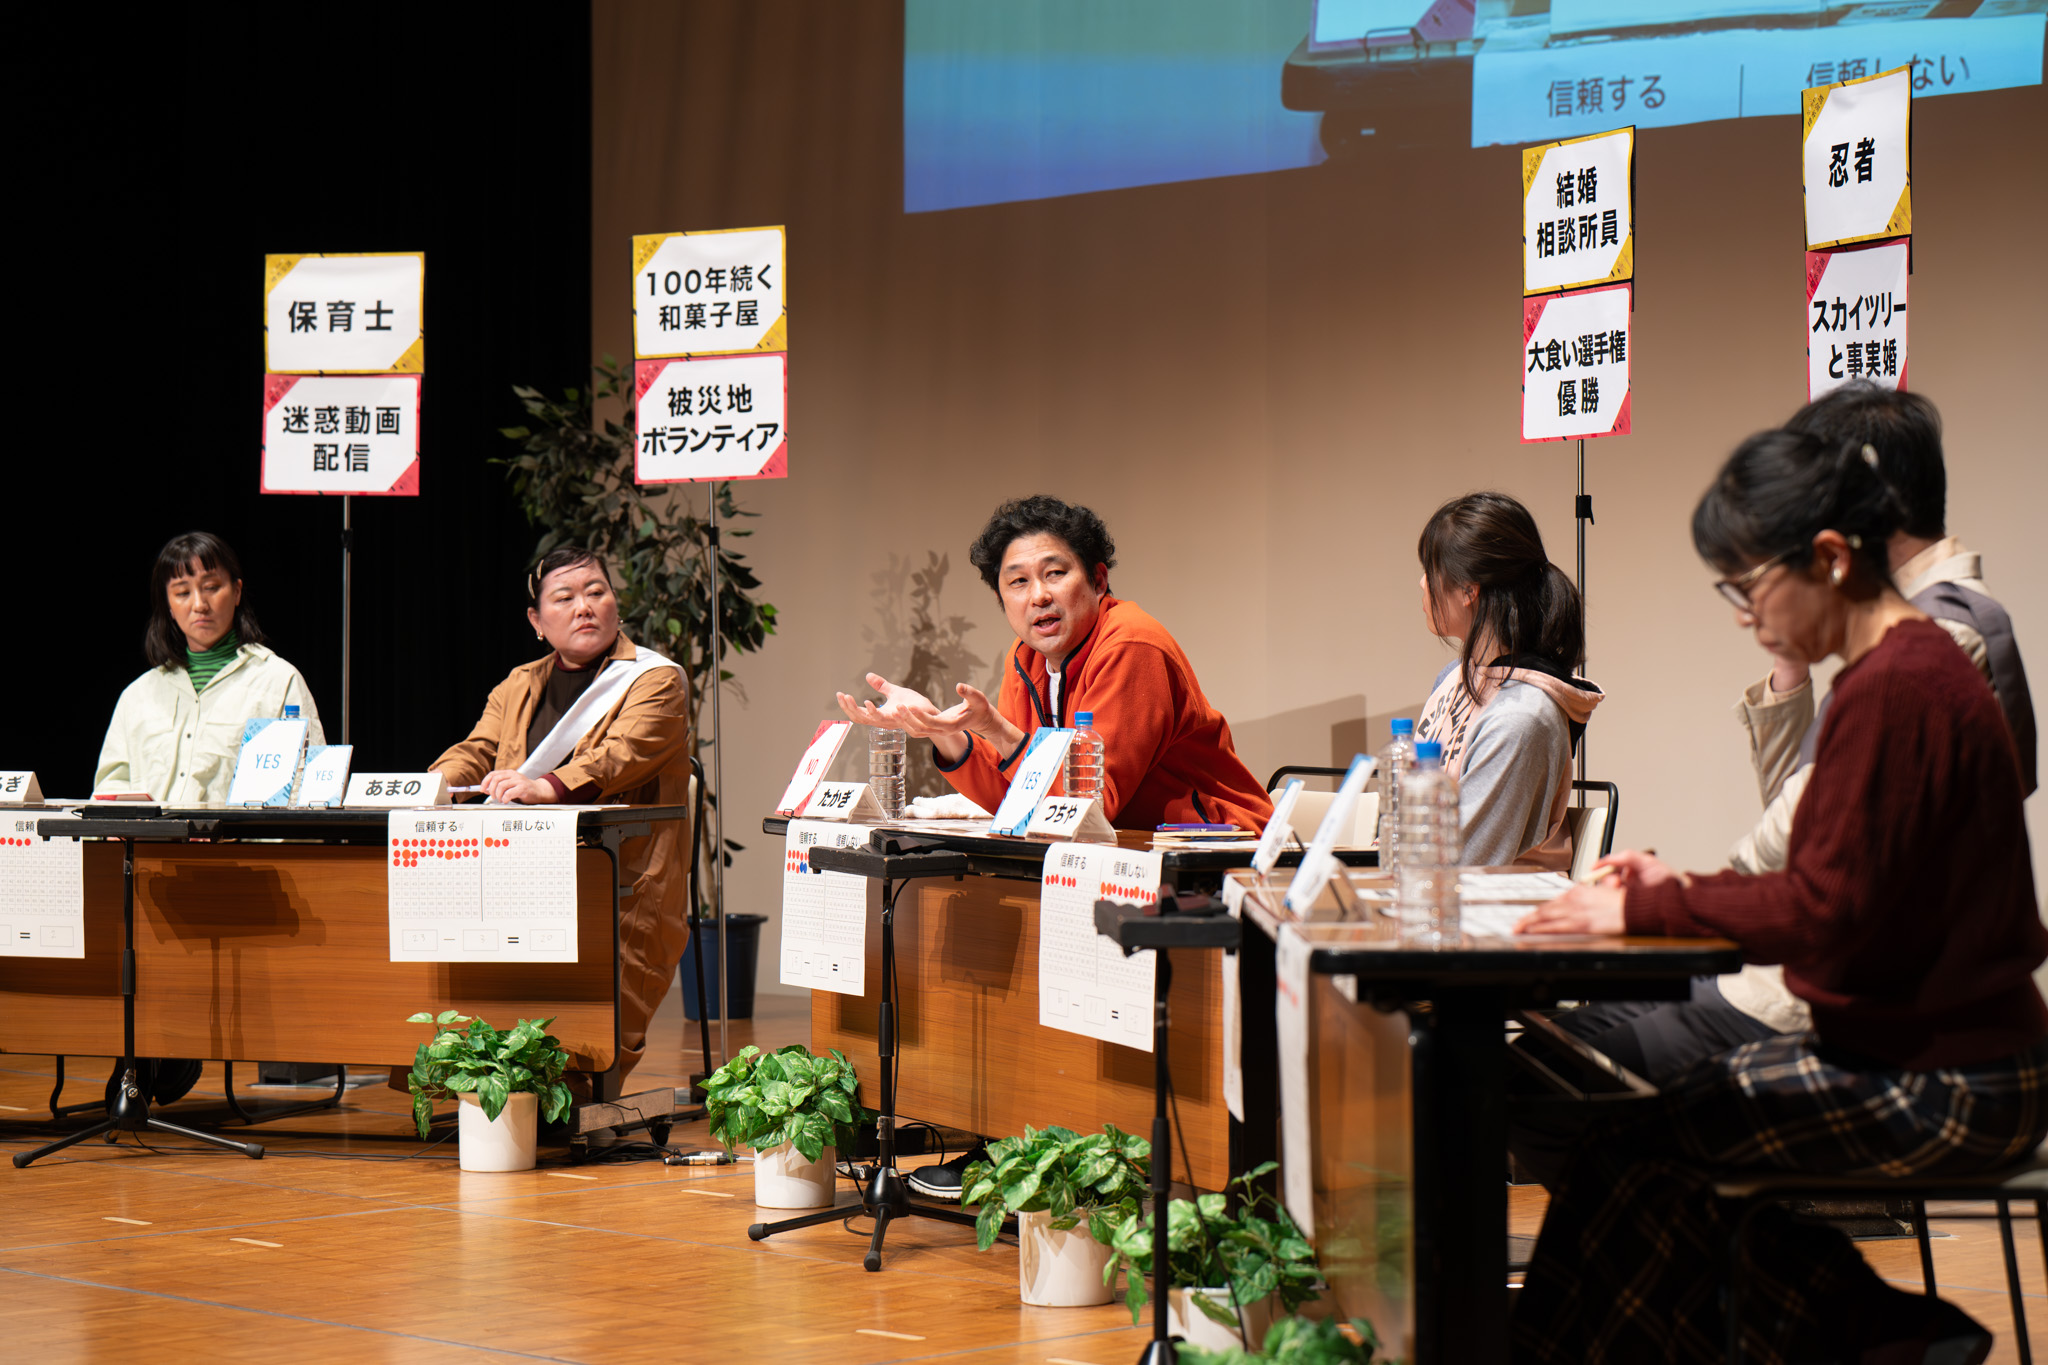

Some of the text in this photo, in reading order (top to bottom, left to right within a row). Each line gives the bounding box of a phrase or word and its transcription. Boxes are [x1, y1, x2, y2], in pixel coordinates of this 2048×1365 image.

[1547, 74, 1666, 119] 信頼する
[1828, 137, 1875, 188] 忍者
[1556, 166, 1597, 209] 結婚
[1537, 209, 1618, 259] 相談所員
[647, 264, 772, 296] 100年続く
[288, 300, 393, 333] 保育士
[659, 300, 759, 331] 和菓子屋
[1812, 292, 1906, 333] スカイツリー
[1527, 329, 1626, 373] 大食い選手権
[1828, 338, 1897, 379] と事実婚
[668, 383, 753, 417] 被災地
[1557, 376, 1599, 417] 優勝
[282, 405, 400, 435] 迷惑動画
[642, 422, 779, 456] ボランティア
[313, 443, 370, 472] 配信
[255, 753, 281, 769] YES
[315, 770, 334, 781] YES
[804, 758, 817, 775] NO
[365, 779, 421, 797] あまの
[1021, 771, 1041, 791] YES
[816, 788, 855, 809] たかぎ
[414, 820, 458, 833] 信頼する
[501, 819, 555, 832] 信頼しない
[1044, 804, 1078, 825] つちや
[1060, 852, 1087, 870] 信頼する
[1114, 861, 1148, 878] 信頼しない
